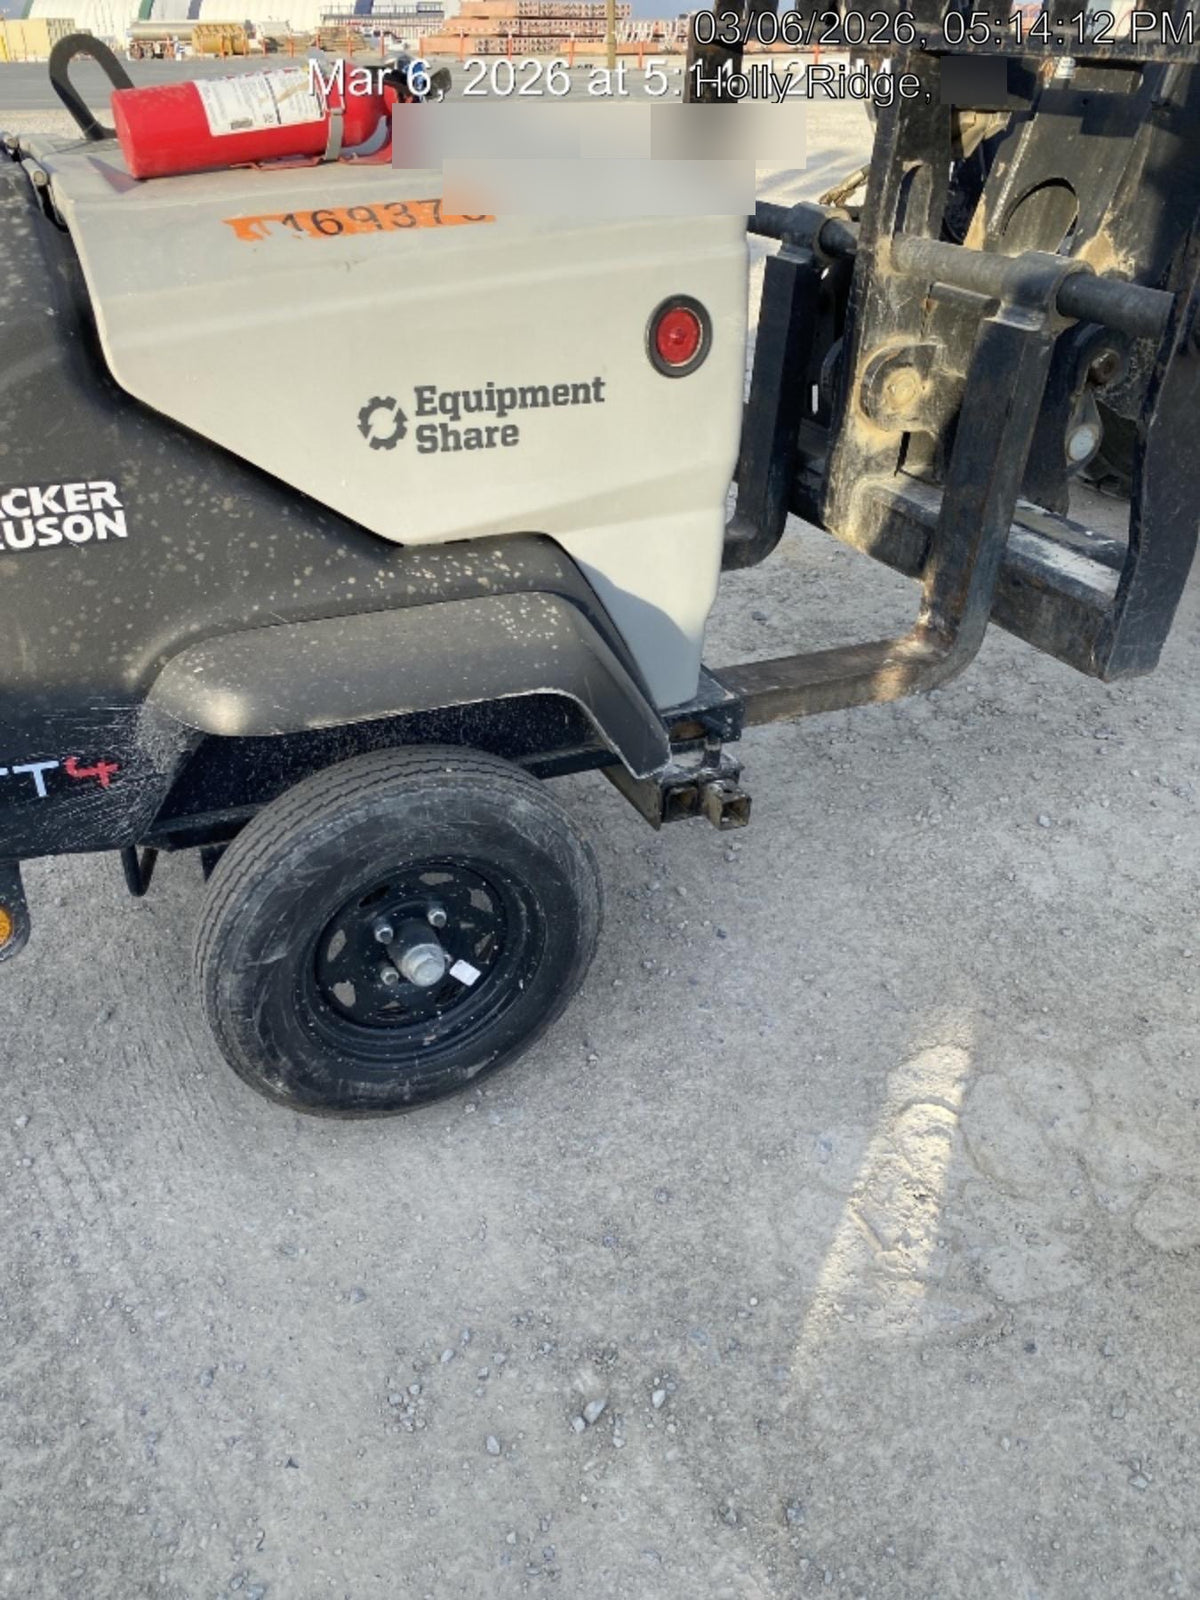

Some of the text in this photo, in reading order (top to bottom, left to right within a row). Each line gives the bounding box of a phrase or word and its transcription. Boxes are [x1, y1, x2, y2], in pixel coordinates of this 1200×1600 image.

[414, 376, 606, 421] Equipment
[415, 422, 520, 454] Share
[0, 481, 124, 519] CKER
[0, 510, 128, 550] USON
